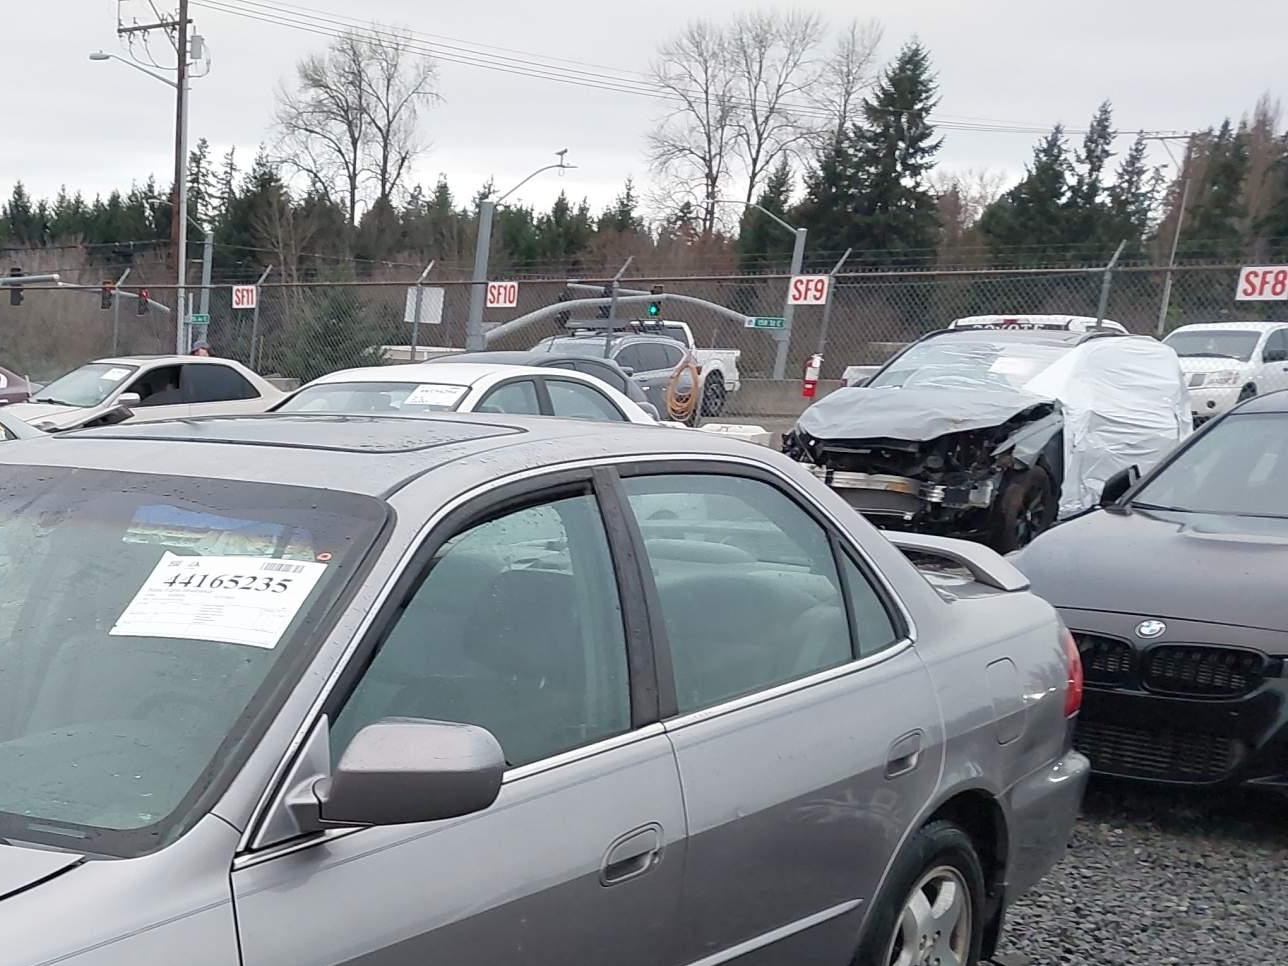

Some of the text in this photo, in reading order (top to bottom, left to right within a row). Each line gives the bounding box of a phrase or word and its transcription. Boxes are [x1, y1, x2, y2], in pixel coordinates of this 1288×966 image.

[489, 284, 516, 304] SF10
[792, 278, 825, 301] SF9
[1242, 270, 1288, 297] SF8
[235, 288, 253, 306] SF11
[163, 573, 293, 594] 44165235
